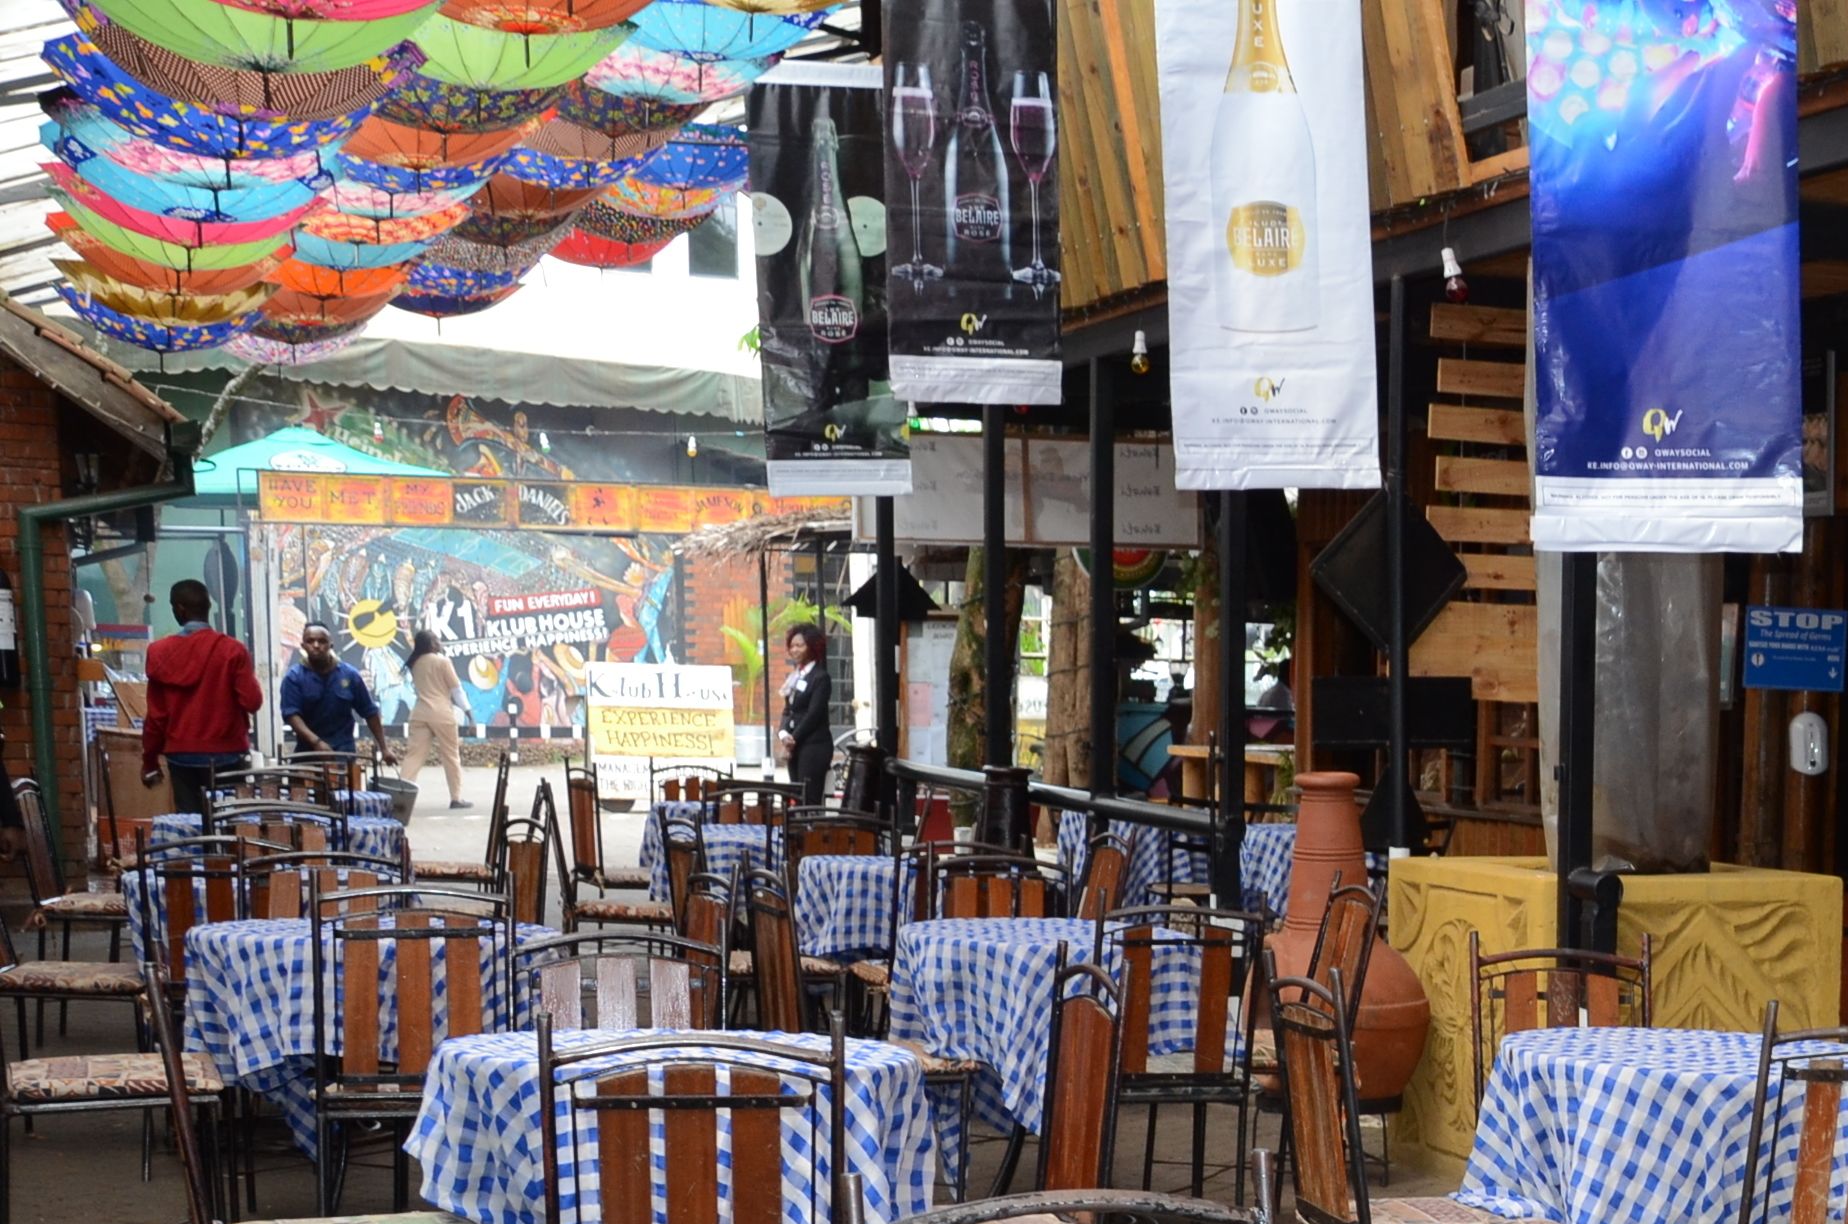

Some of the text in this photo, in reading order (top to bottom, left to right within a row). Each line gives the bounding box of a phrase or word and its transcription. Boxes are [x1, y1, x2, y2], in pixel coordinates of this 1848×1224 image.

[955, 208, 1000, 226] BELAIRE
[1232, 227, 1300, 249] BELAIRE
[811, 310, 855, 327] BELAIRE
[1654, 448, 1711, 458] QWAYSOCIAL
[1587, 461, 1749, 471] KE.INFO@QWAY-INTERNATIONAL.COM
[268, 478, 316, 494] HAVE
[274, 496, 312, 509] YOU
[330, 491, 375, 505] MET
[455, 484, 571, 526] JACK DANIELS
[494, 591, 596, 613] FUN EVERYDAY!
[428, 599, 476, 640] K1
[1750, 610, 1843, 630] STOP
[441, 626, 609, 658] XPERIENCE HAPPINESS!
[1760, 628, 1773, 637] The
[1774, 629, 1799, 639] Spread
[1800, 630, 1809, 641] of
[601, 709, 717, 728] EXPERIENCE
[606, 729, 715, 755] HAPPINESS!
